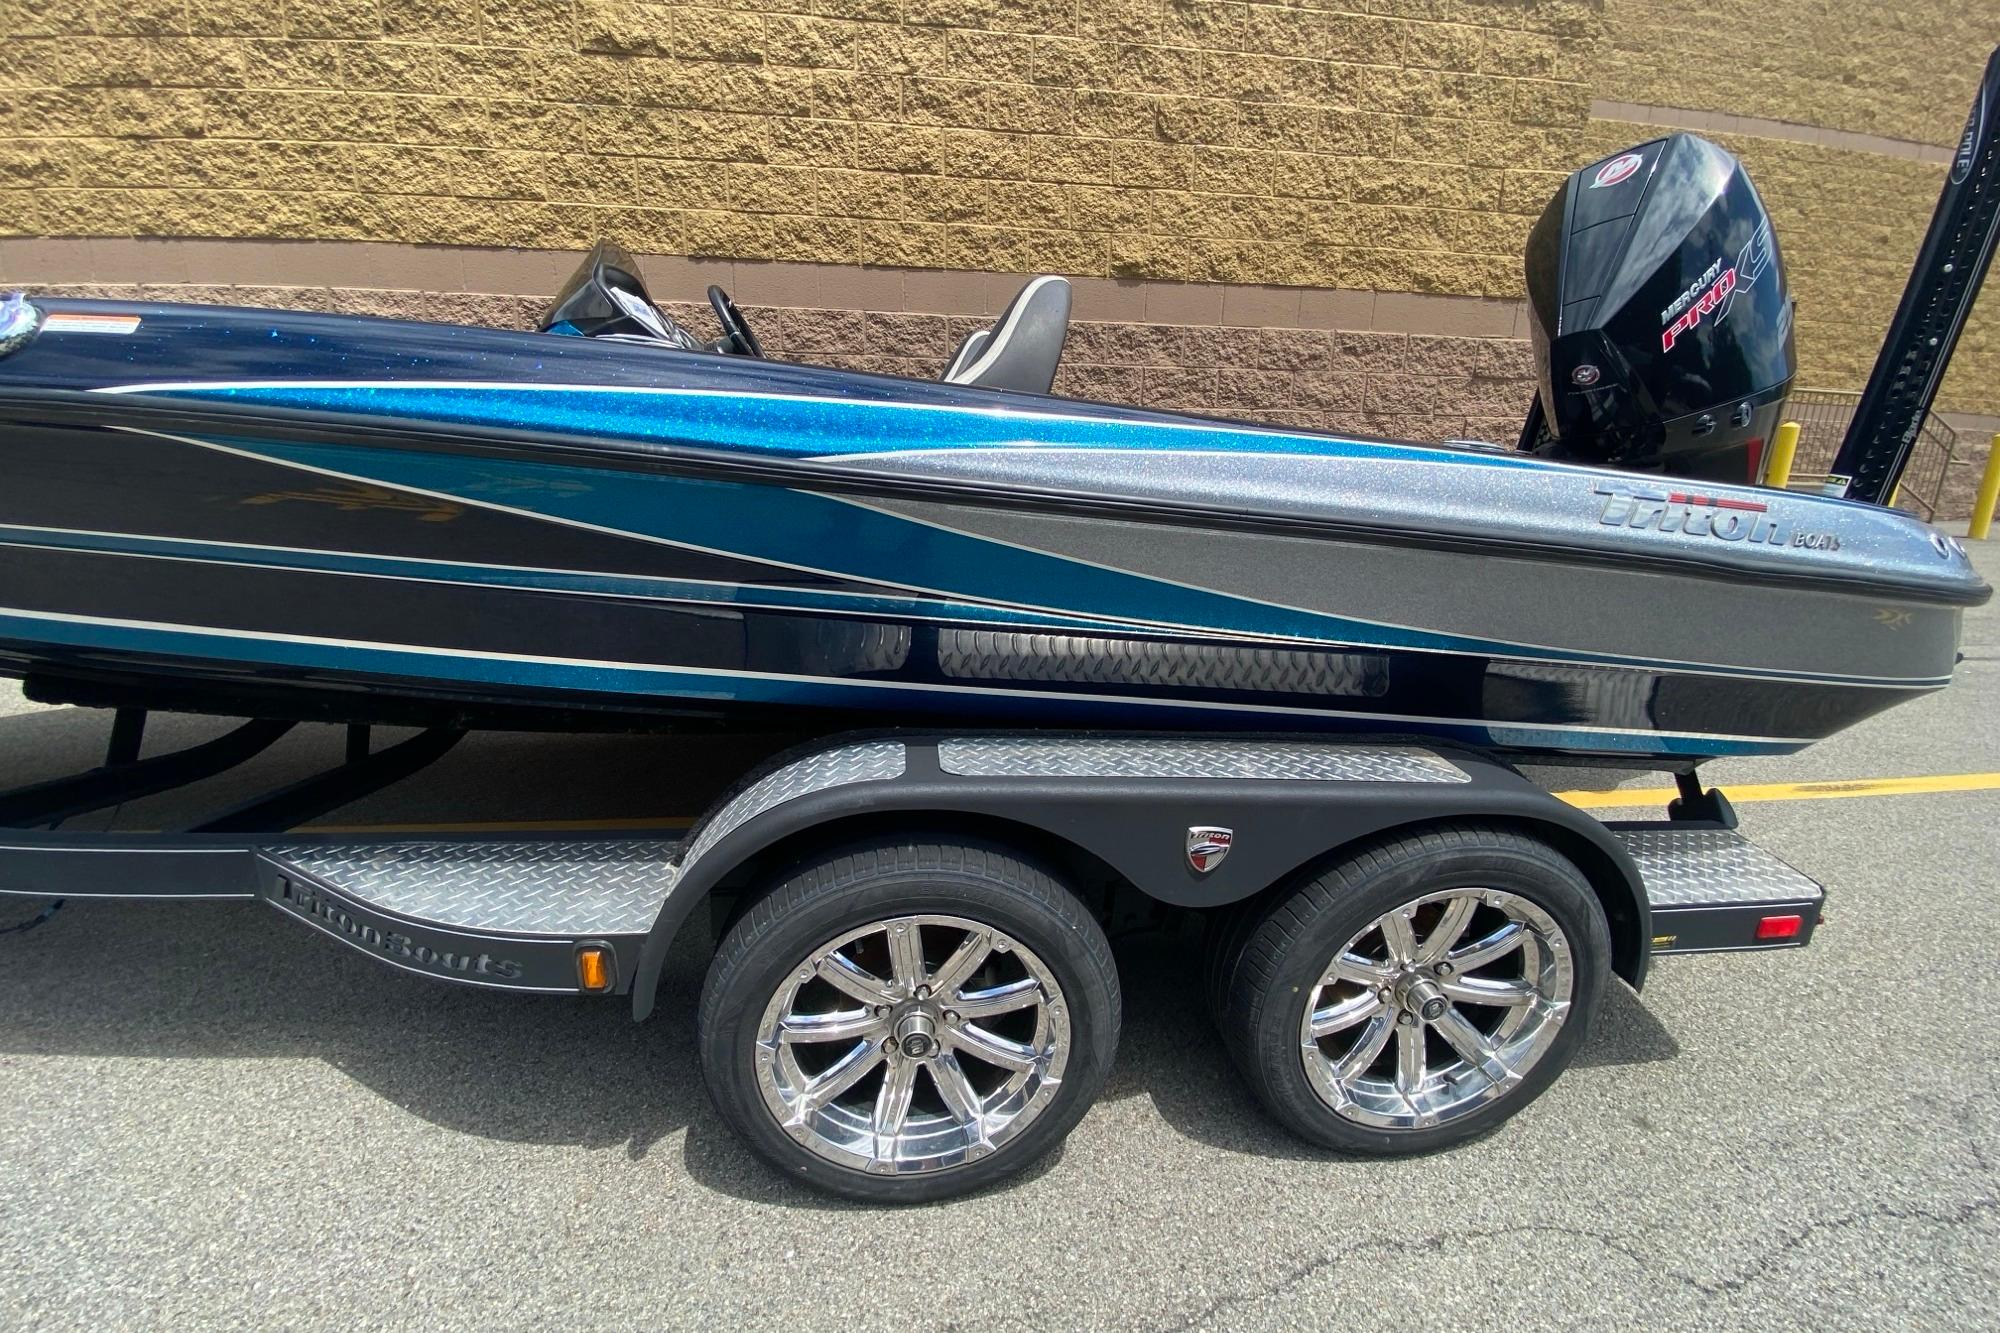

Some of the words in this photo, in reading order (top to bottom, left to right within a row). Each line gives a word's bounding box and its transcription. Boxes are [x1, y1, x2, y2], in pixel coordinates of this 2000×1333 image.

[1661, 256, 1722, 325] MERCURY
[1662, 267, 1736, 353] PRO
[1593, 489, 1793, 547] Triton
[1792, 531, 1842, 551] BOATS
